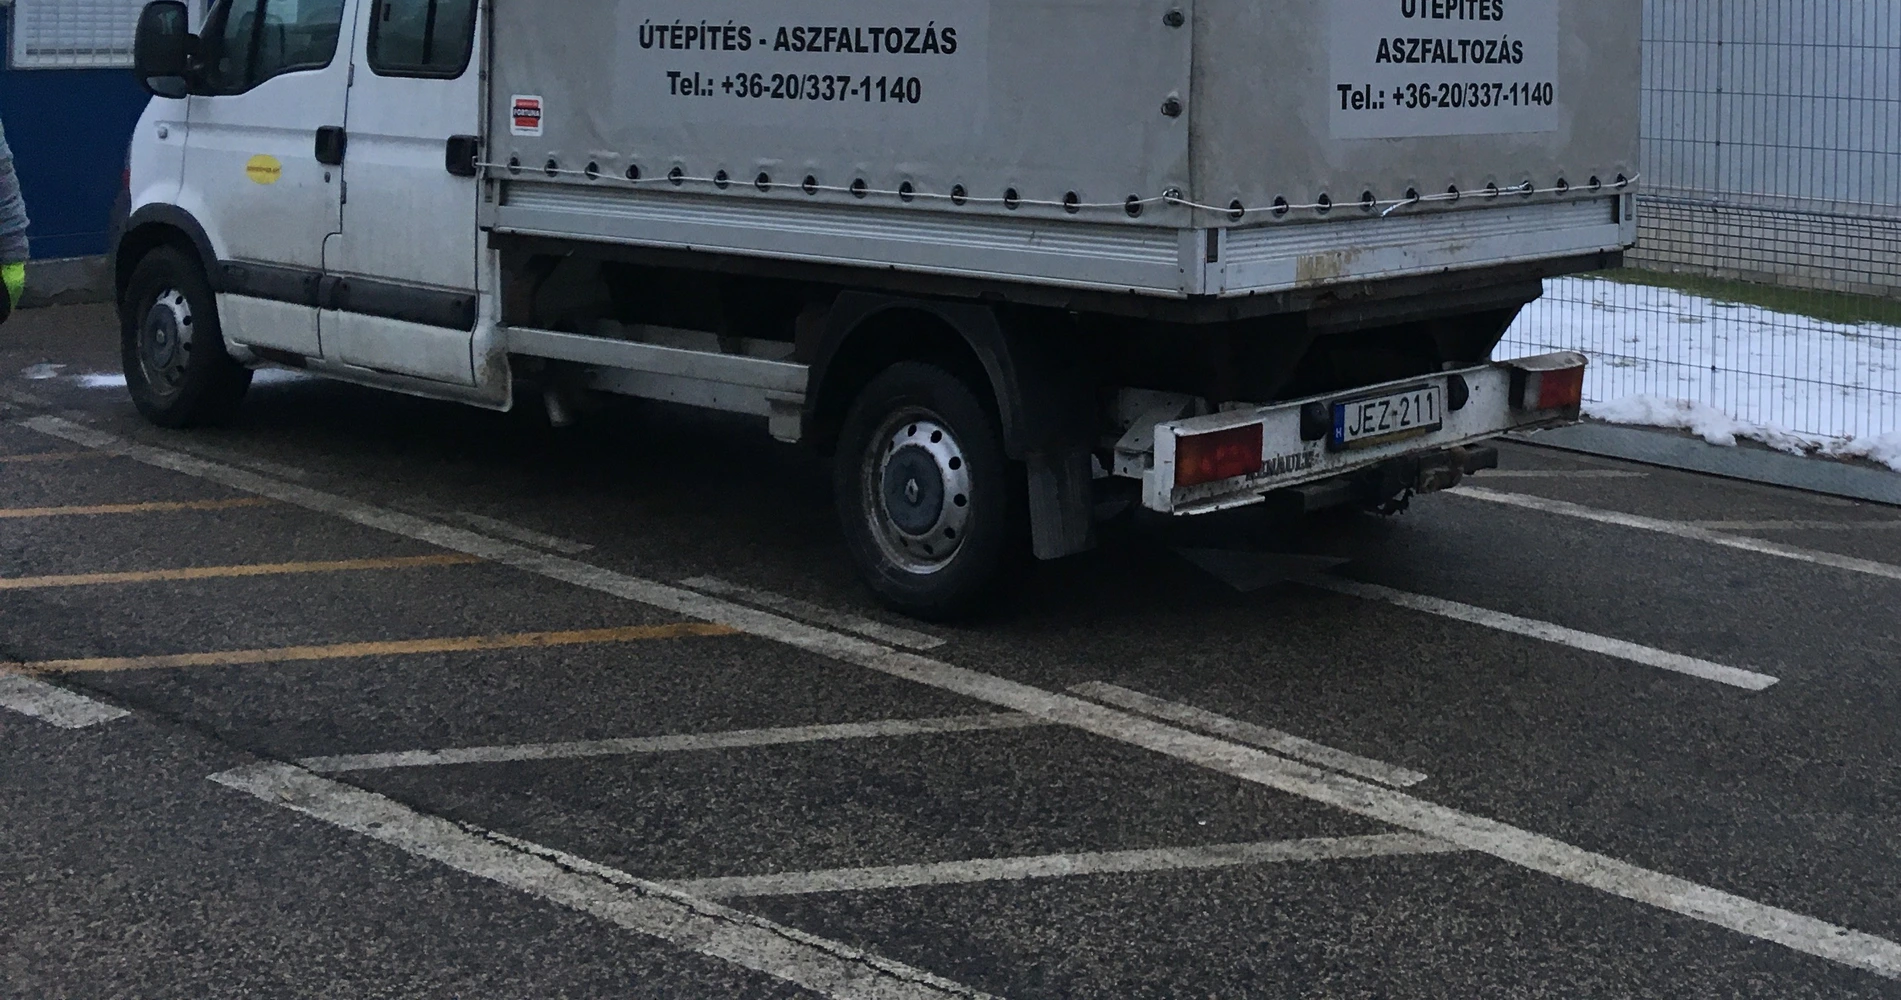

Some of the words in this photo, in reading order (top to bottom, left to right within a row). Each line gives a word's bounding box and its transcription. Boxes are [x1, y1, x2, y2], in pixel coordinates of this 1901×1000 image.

[639, 19, 752, 51] ÚTÉPÍTÉS
[773, 21, 958, 55] ASZFALTOZÁS
[1375, 34, 1524, 65] ASZFALTOZÁS
[667, 71, 714, 97] Tel.:
[721, 73, 922, 104] +36-20/337-1140
[1337, 84, 1385, 111] Tel.:
[1392, 82, 1554, 109] +36-20/337-1140
